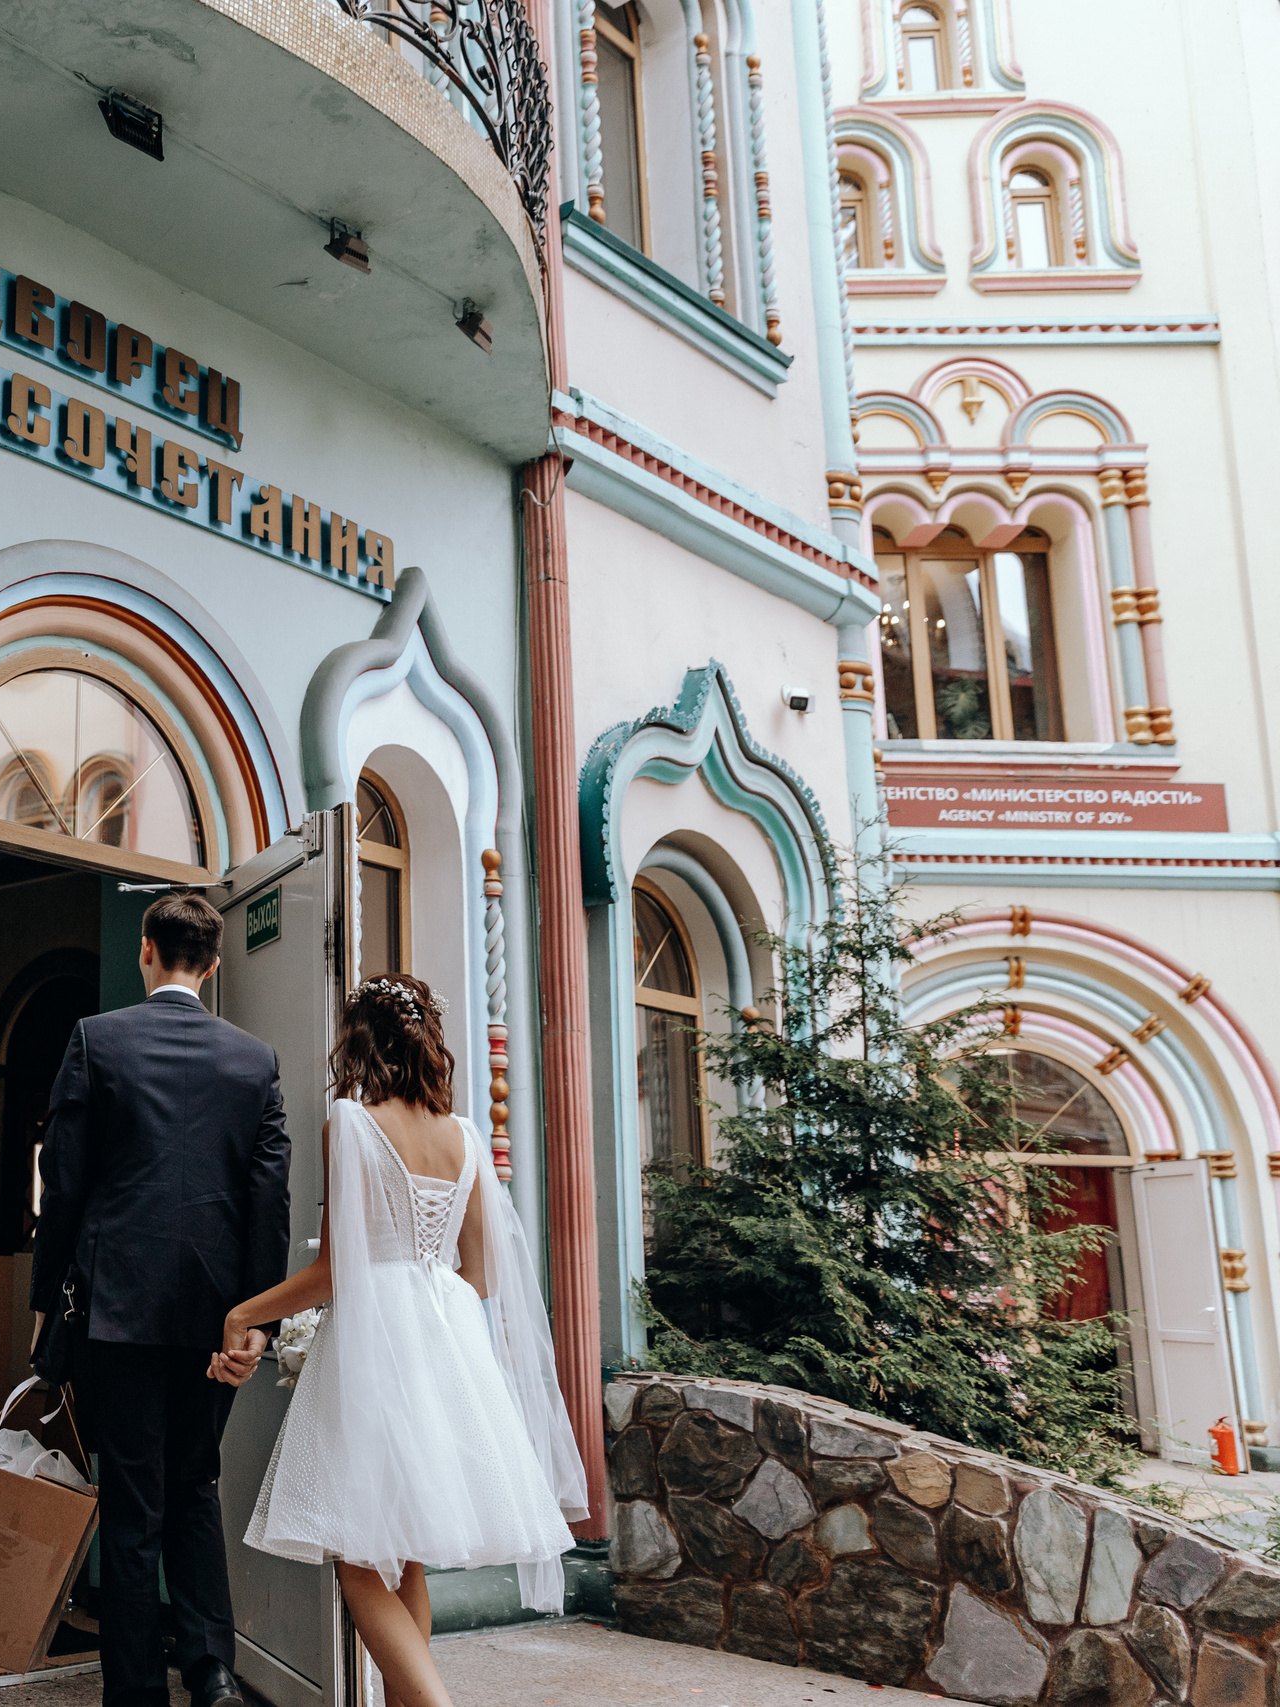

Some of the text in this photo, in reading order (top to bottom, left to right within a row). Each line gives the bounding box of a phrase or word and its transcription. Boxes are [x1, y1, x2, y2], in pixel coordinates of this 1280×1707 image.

[962, 788, 1108, 804] «МИНИСТЕРСТВО
[1111, 790, 1203, 807] РАДОСТИ»
[938, 809, 1133, 824] AGENCY «MINISTRY OF JOY»
[248, 898, 278, 937] ВЫХОД
